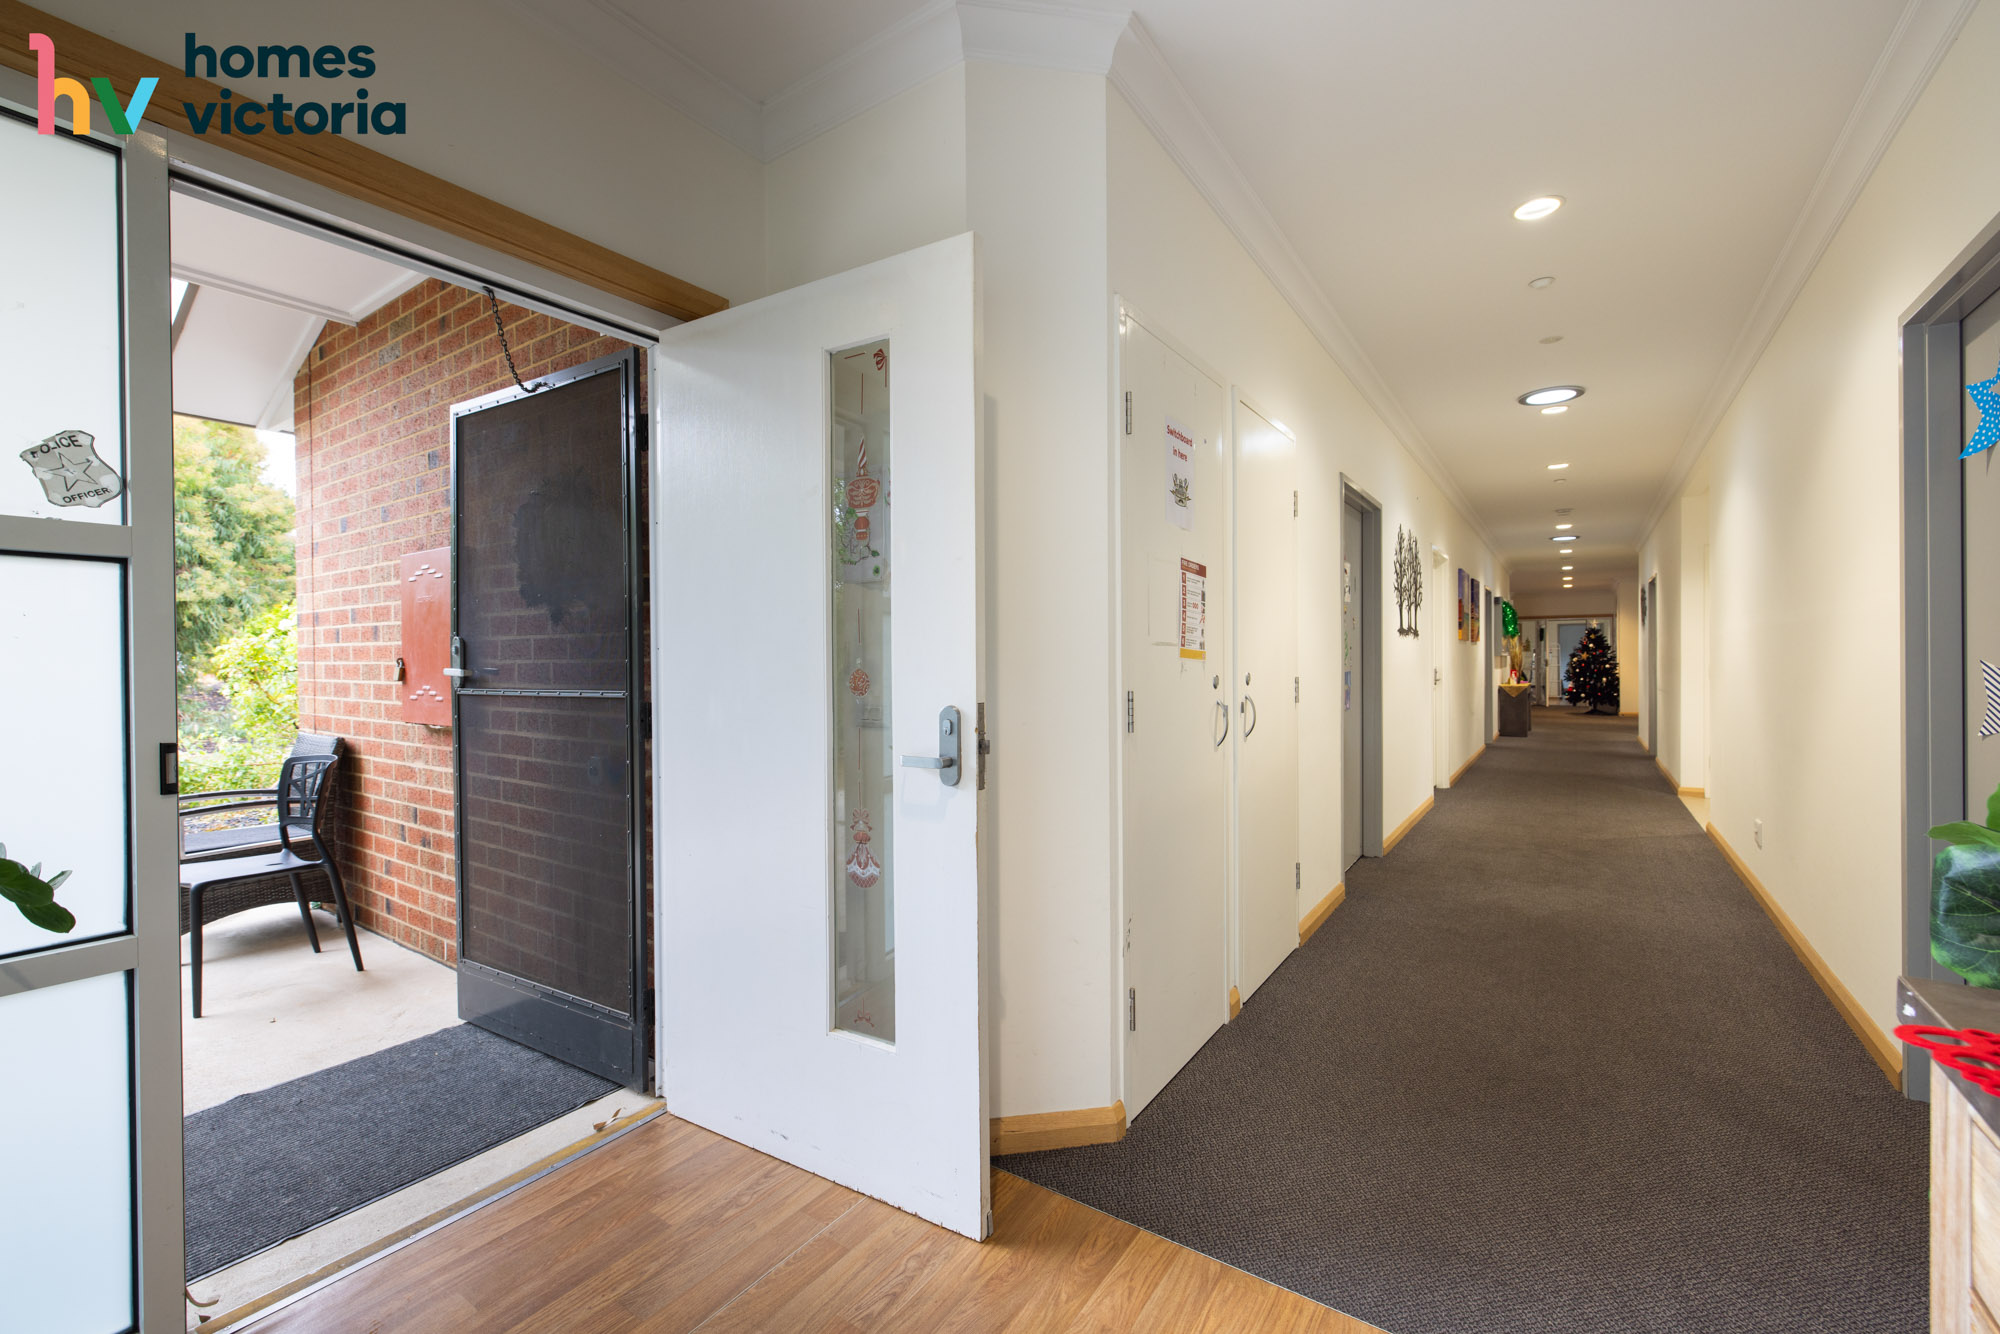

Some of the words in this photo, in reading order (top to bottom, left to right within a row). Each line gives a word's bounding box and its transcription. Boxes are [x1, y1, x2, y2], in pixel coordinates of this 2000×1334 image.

[1167, 424, 1193, 447] Switchboard
[1172, 445, 1178, 457] in
[1178, 448, 1188, 462] here
[62, 487, 110, 504] OFFICER
